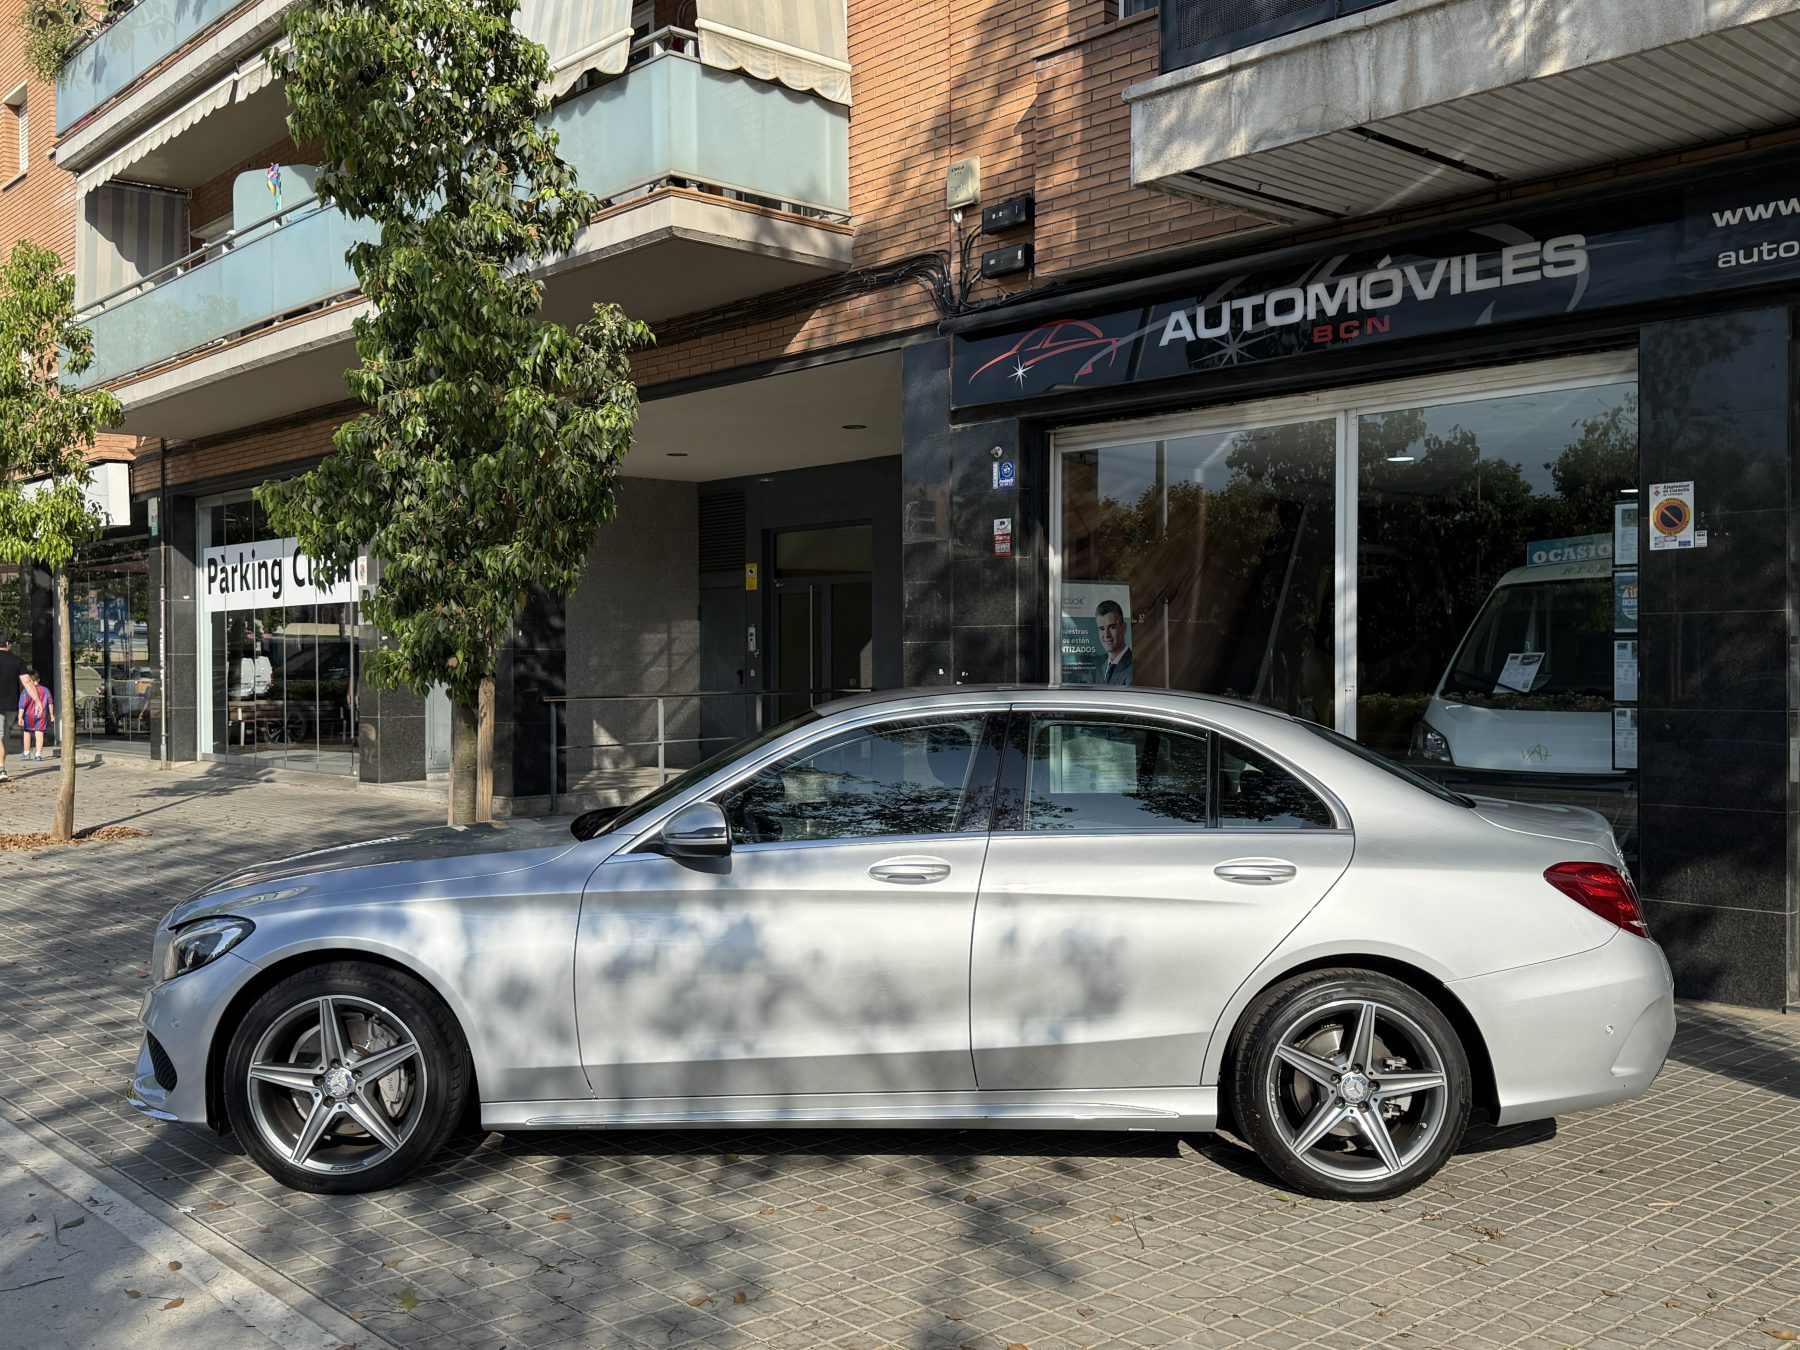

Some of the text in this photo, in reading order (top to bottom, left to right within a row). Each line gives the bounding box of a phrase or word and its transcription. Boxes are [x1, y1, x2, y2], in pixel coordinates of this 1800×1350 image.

[1712, 197, 1800, 228] www
[1717, 240, 1800, 268] auto
[1158, 233, 1587, 348] AUTOMÓVILES
[1312, 314, 1391, 344] BCN
[207, 549, 283, 599] Pàrking
